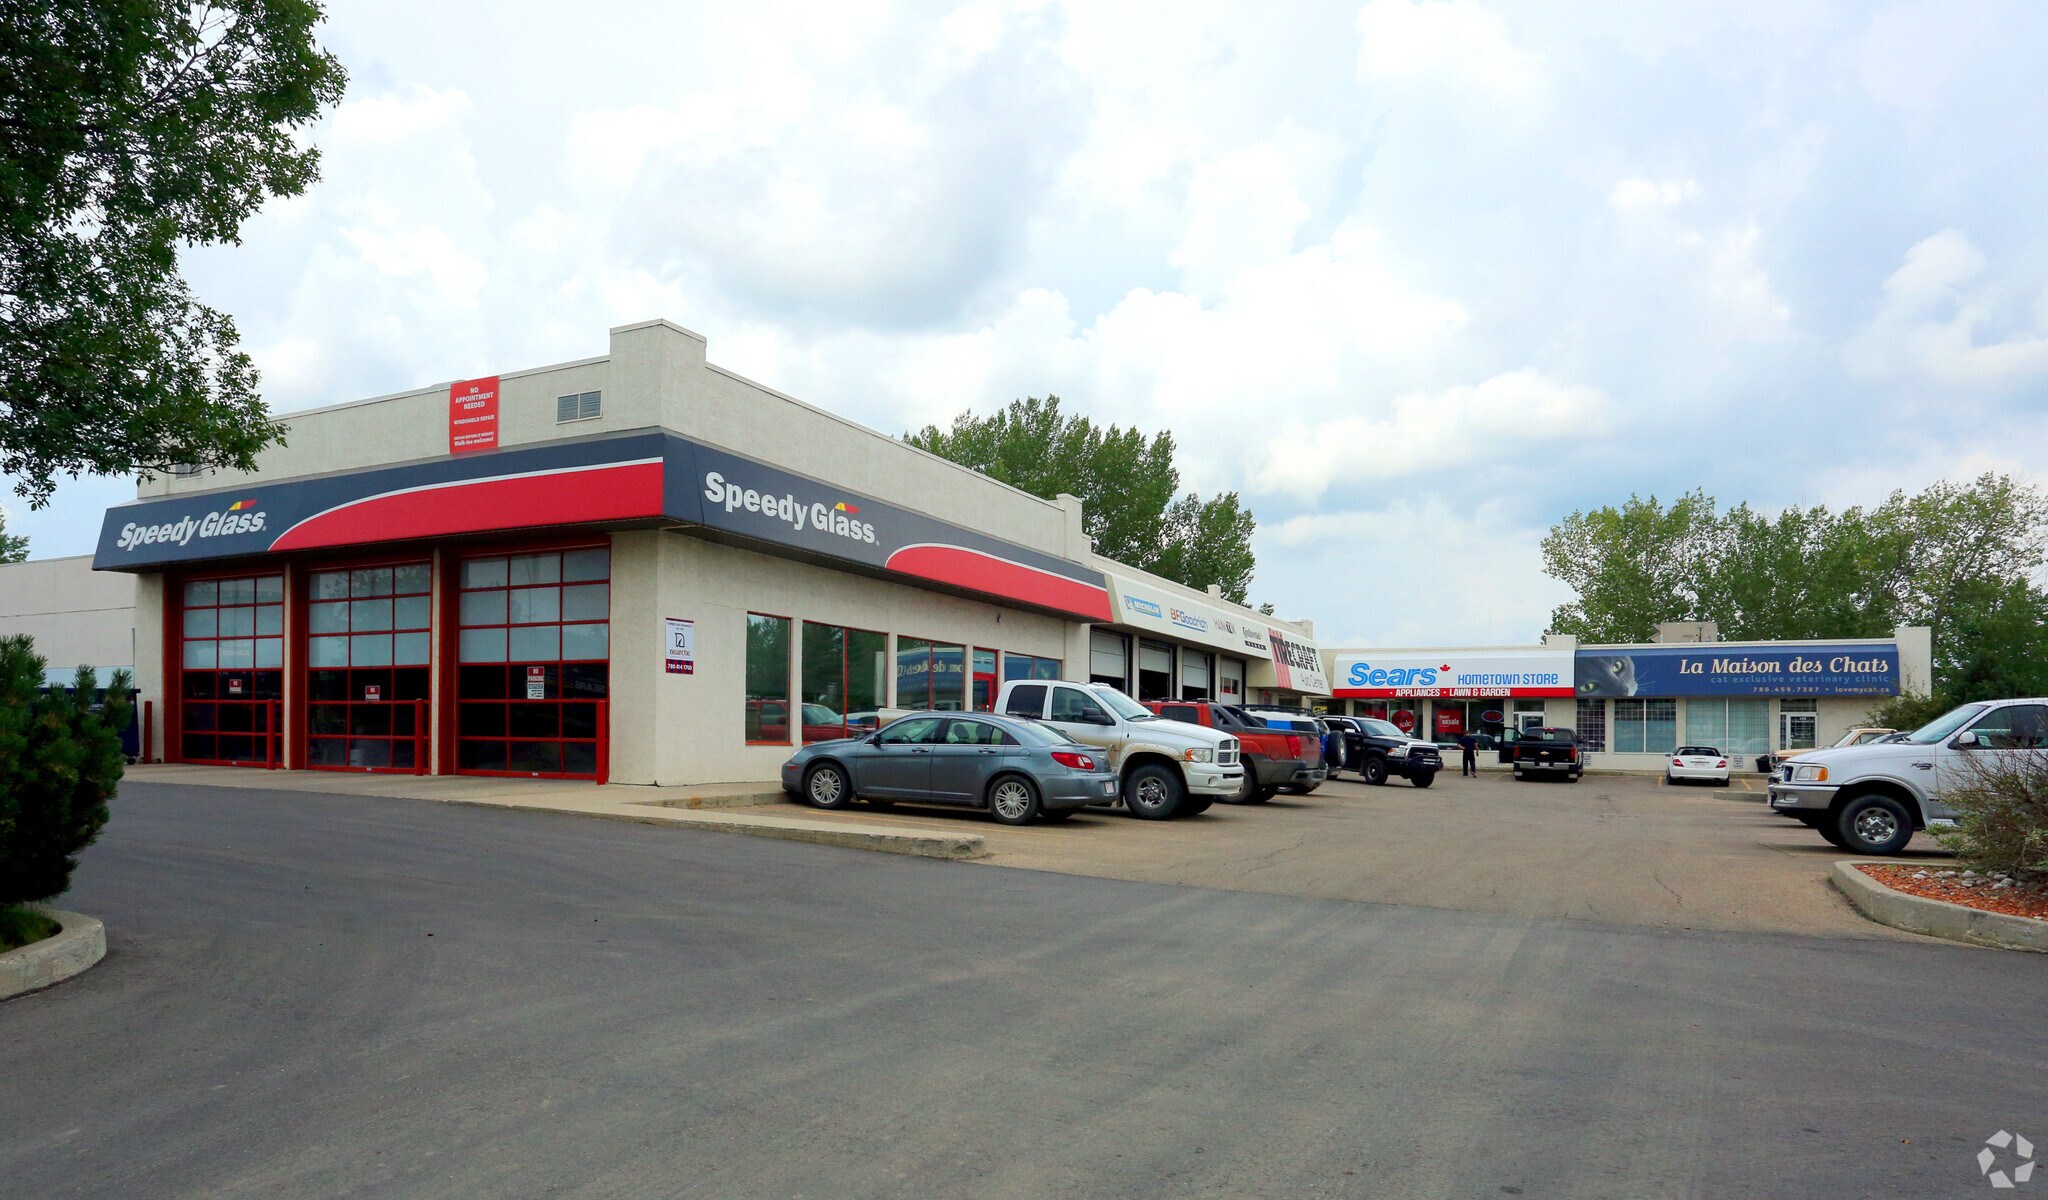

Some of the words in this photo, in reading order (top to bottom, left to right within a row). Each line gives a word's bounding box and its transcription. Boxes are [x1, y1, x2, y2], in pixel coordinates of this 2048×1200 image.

[455, 392, 494, 404] APPOINTMENT
[464, 401, 485, 410] NEEDED
[704, 471, 808, 531] Speedy
[810, 502, 876, 544] Glass
[117, 515, 200, 551] Speedy
[199, 510, 266, 538] Glass
[1679, 659, 1704, 674] La
[1710, 657, 1781, 674] Maison
[1788, 656, 1823, 673] des
[1829, 656, 1889, 673] Chats
[1348, 663, 1437, 686] Sears
[1733, 675, 1784, 683] exclusive
[1789, 675, 1850, 684] veterinary
[1855, 675, 1889, 683] clinic
[1396, 689, 1440, 697] APPLIANCES
[1450, 688, 1471, 696] LAWN
[1472, 688, 1479, 696] &
[1480, 688, 1510, 697] GARDEN
